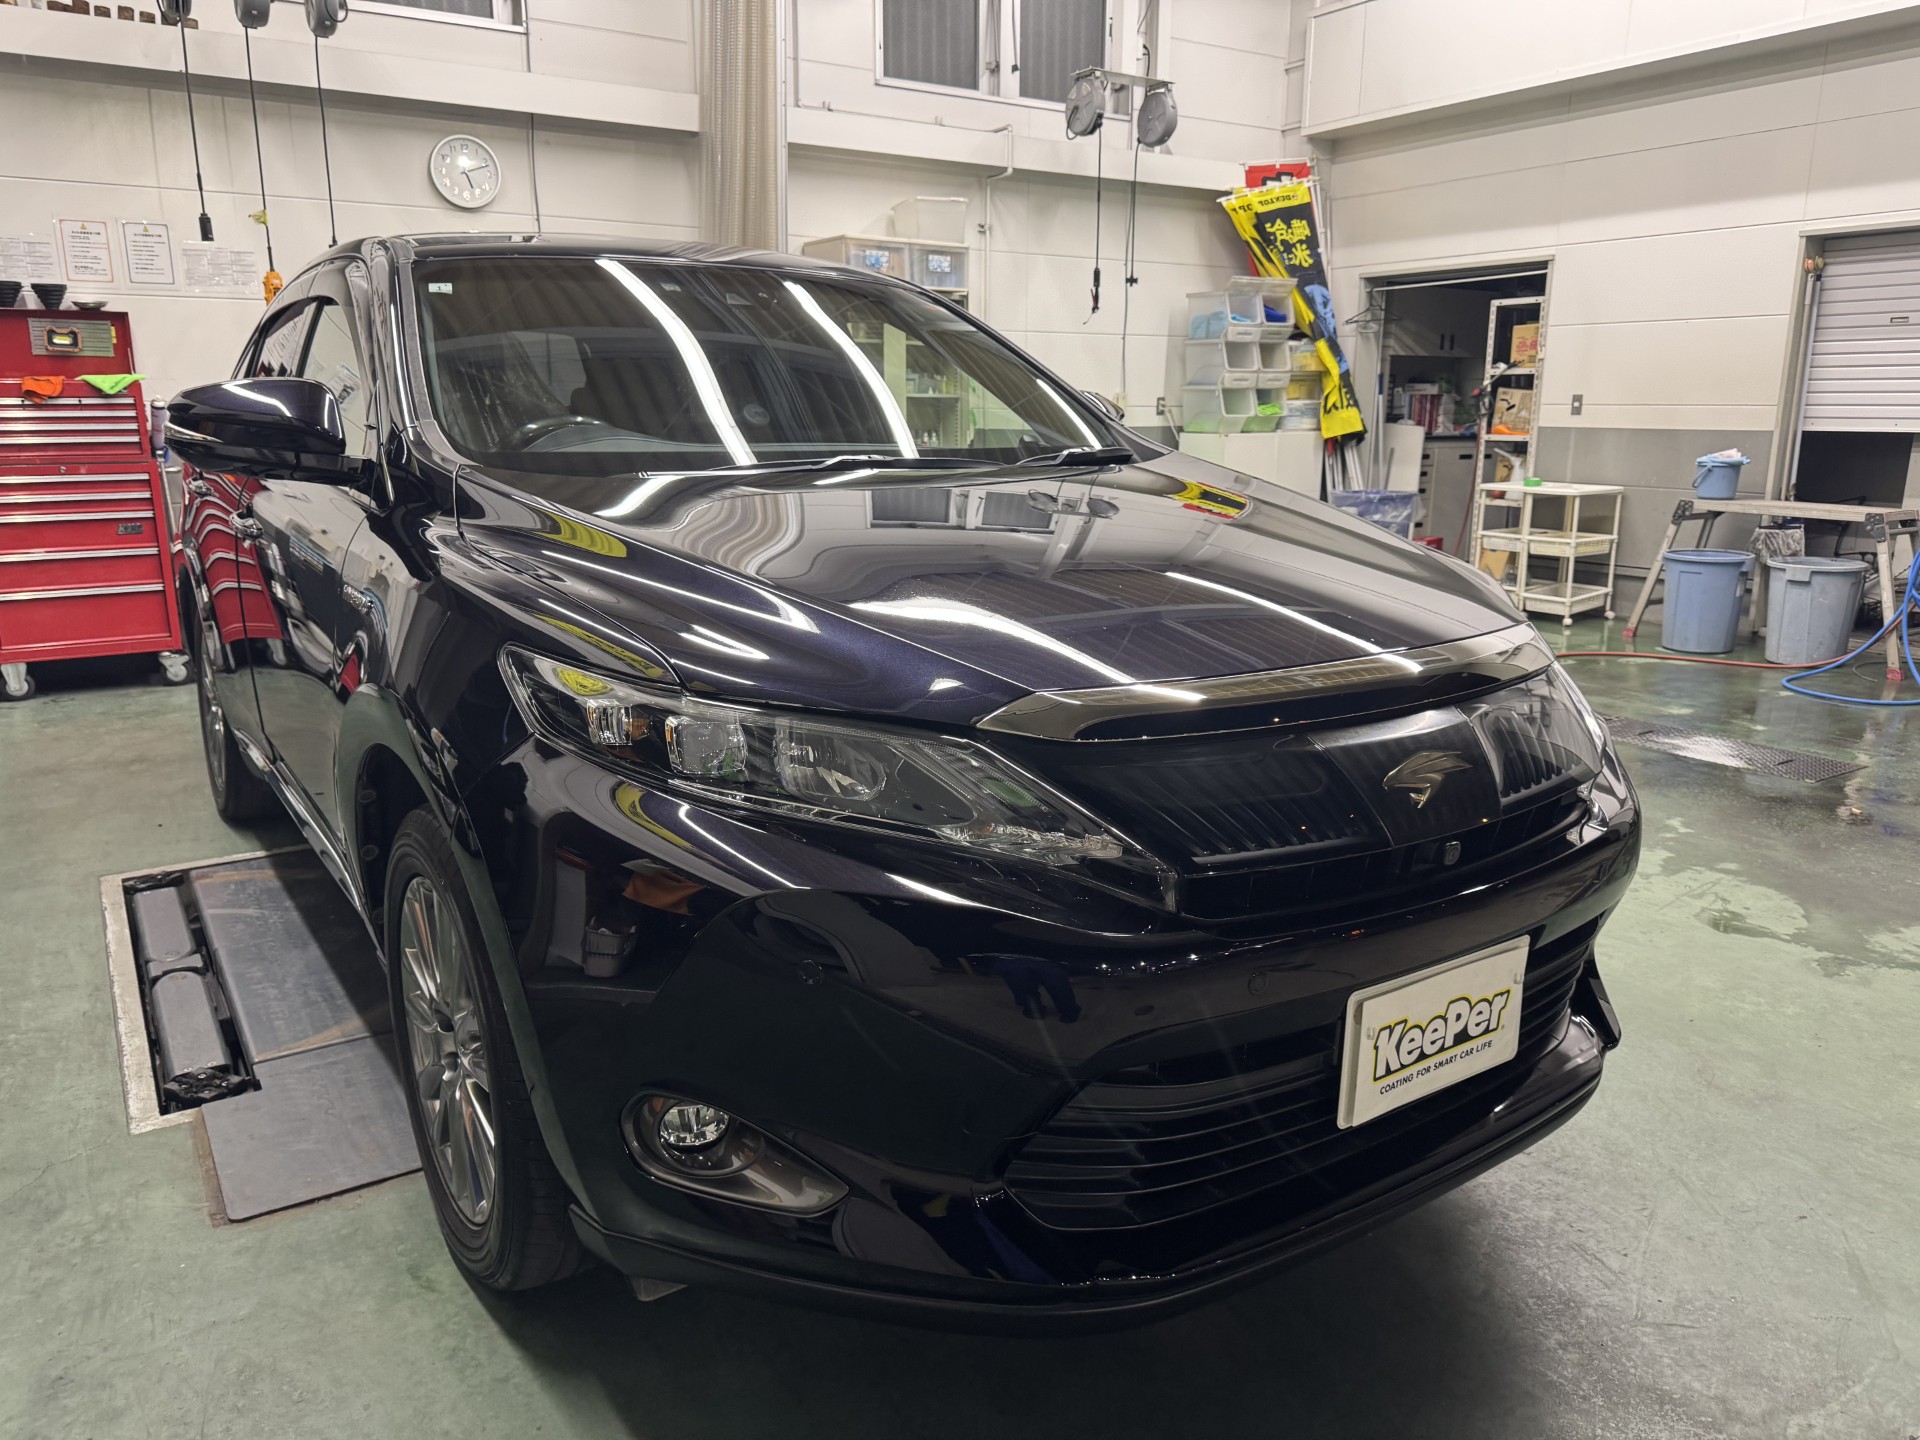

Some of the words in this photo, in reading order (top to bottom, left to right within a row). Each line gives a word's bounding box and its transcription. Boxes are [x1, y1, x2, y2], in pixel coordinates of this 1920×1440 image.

[1373, 989, 1511, 1082] KeePer
[1379, 1074, 1414, 1095] COATING
[1415, 1065, 1432, 1079] FOR
[1433, 1053, 1458, 1070] SMART
[1459, 1046, 1475, 1060] CAR
[1475, 1039, 1493, 1053] LIFE
